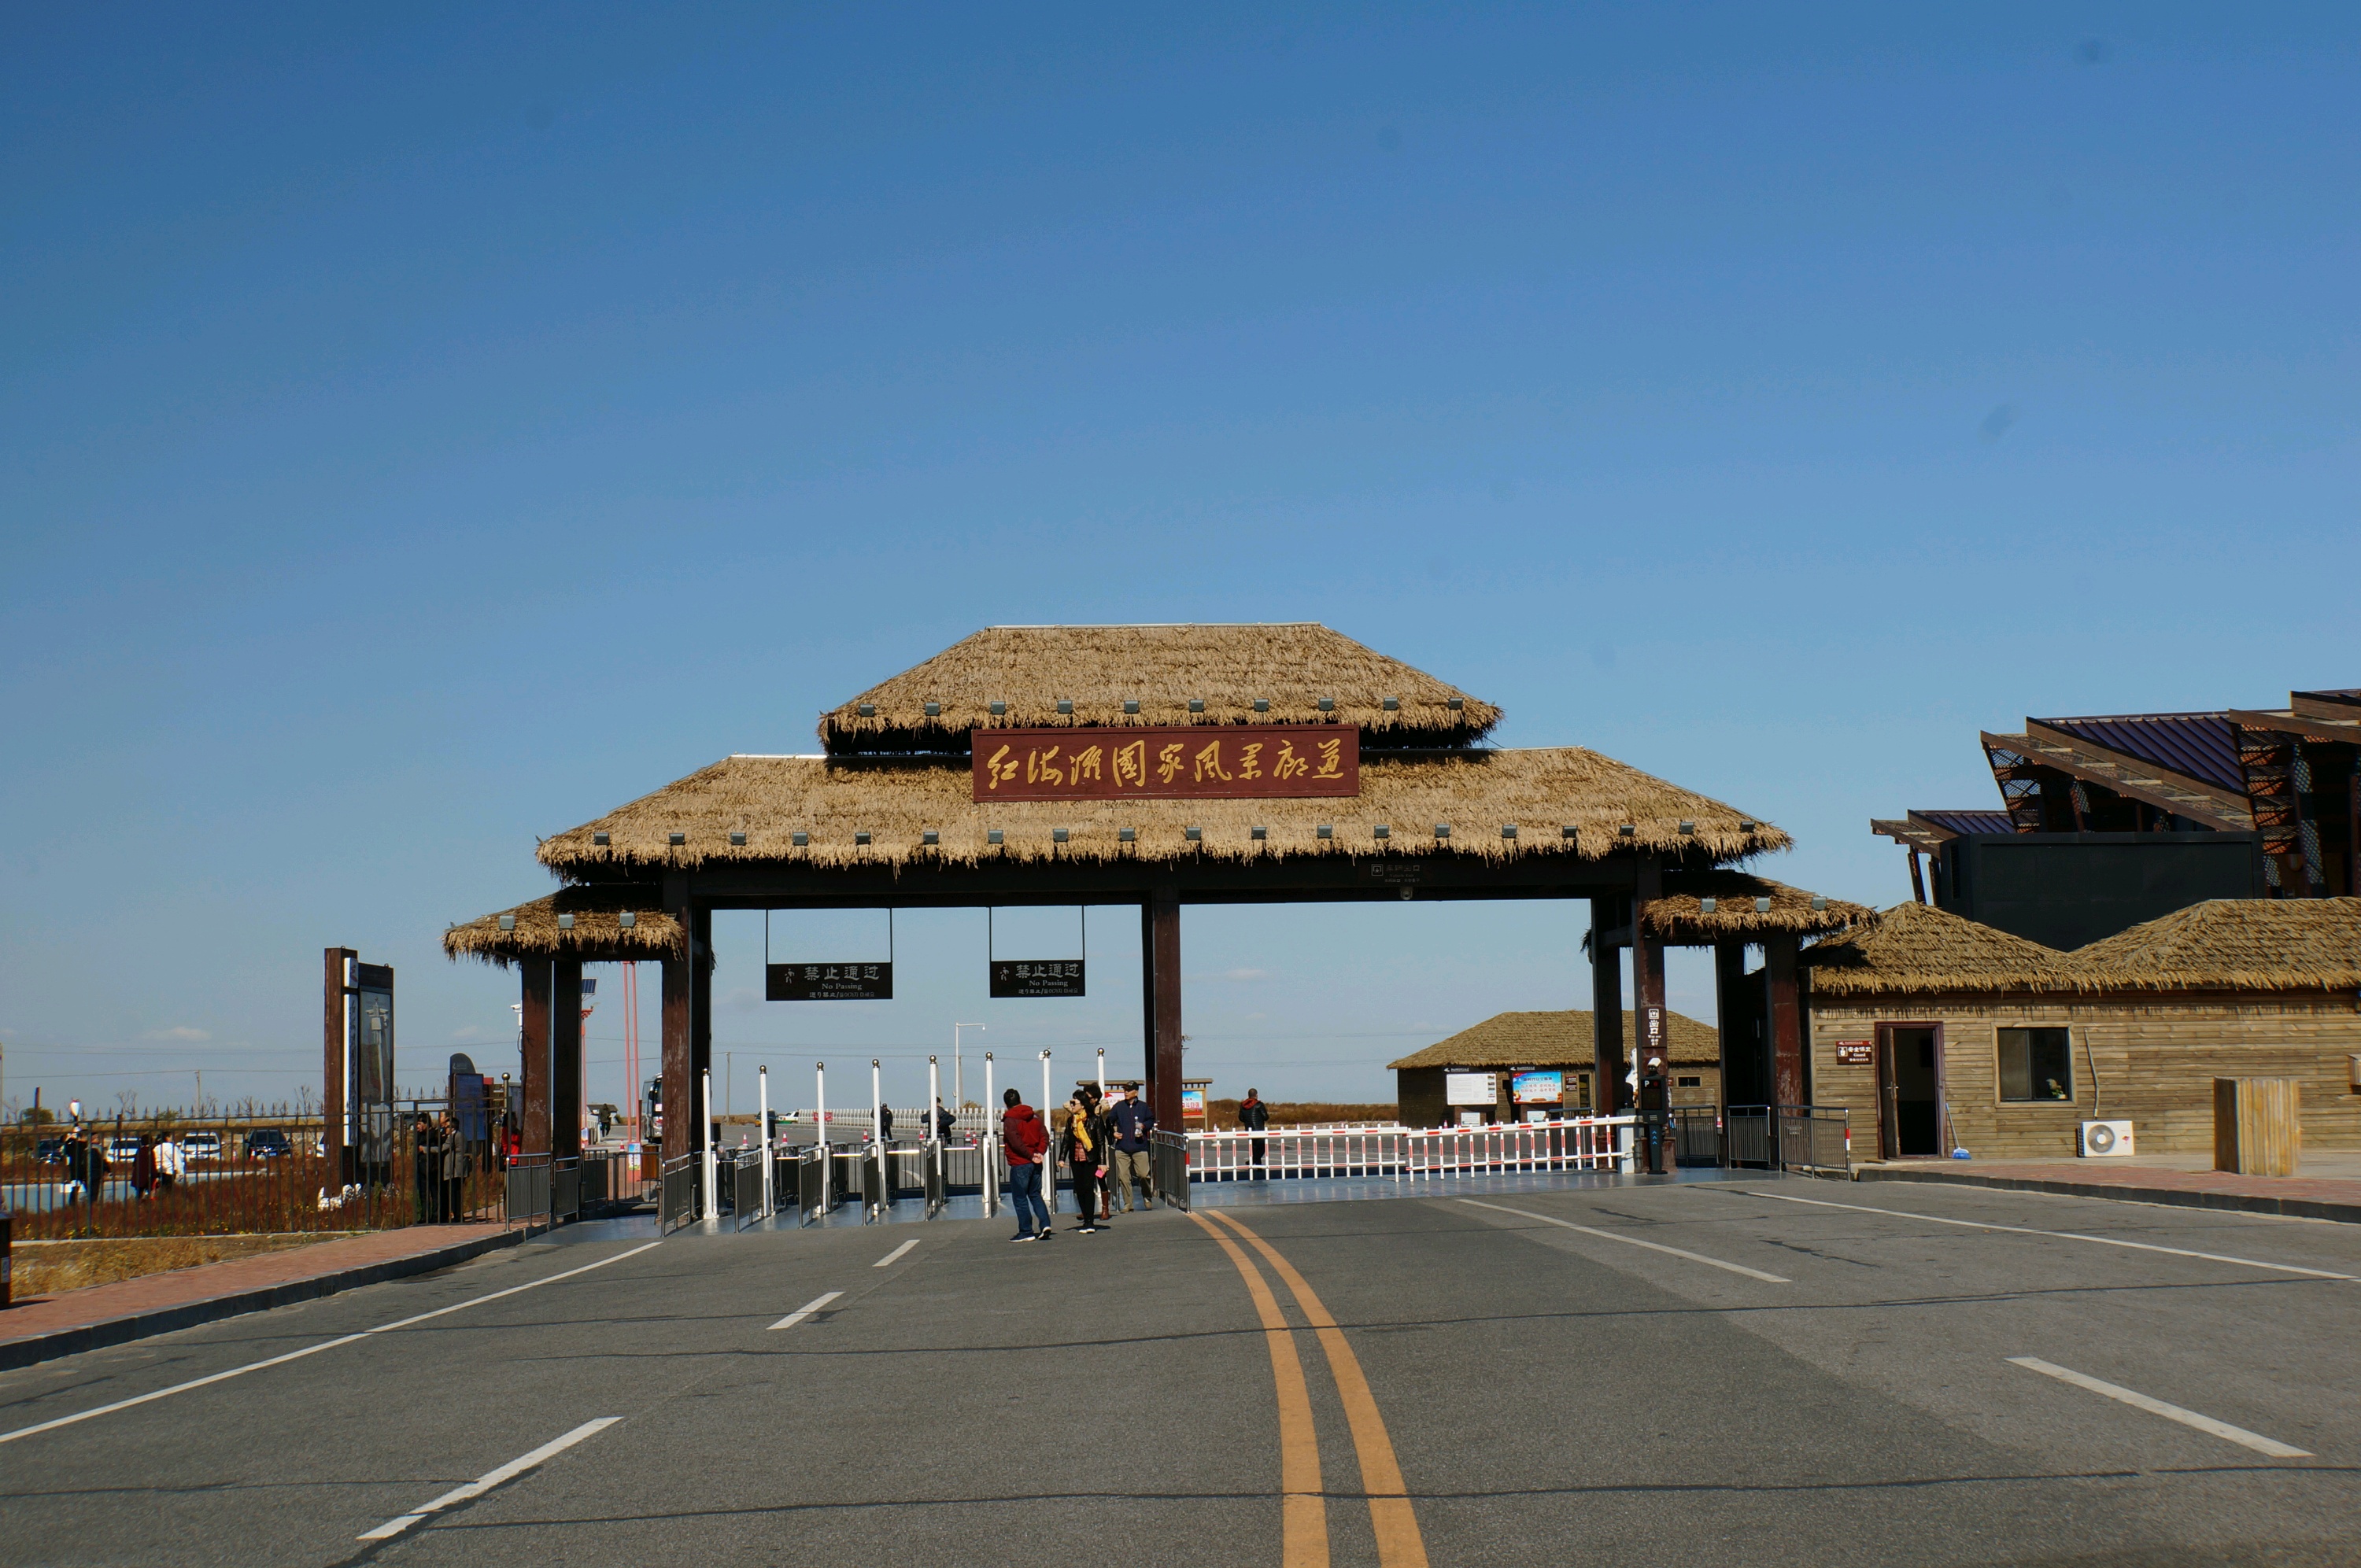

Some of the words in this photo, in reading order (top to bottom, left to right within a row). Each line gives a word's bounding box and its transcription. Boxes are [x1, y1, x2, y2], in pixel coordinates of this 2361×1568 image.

[804, 965, 881, 981] 禁止通过
[1015, 963, 1080, 979] 禁止通过
[1649, 1020, 1660, 1035] 出口
